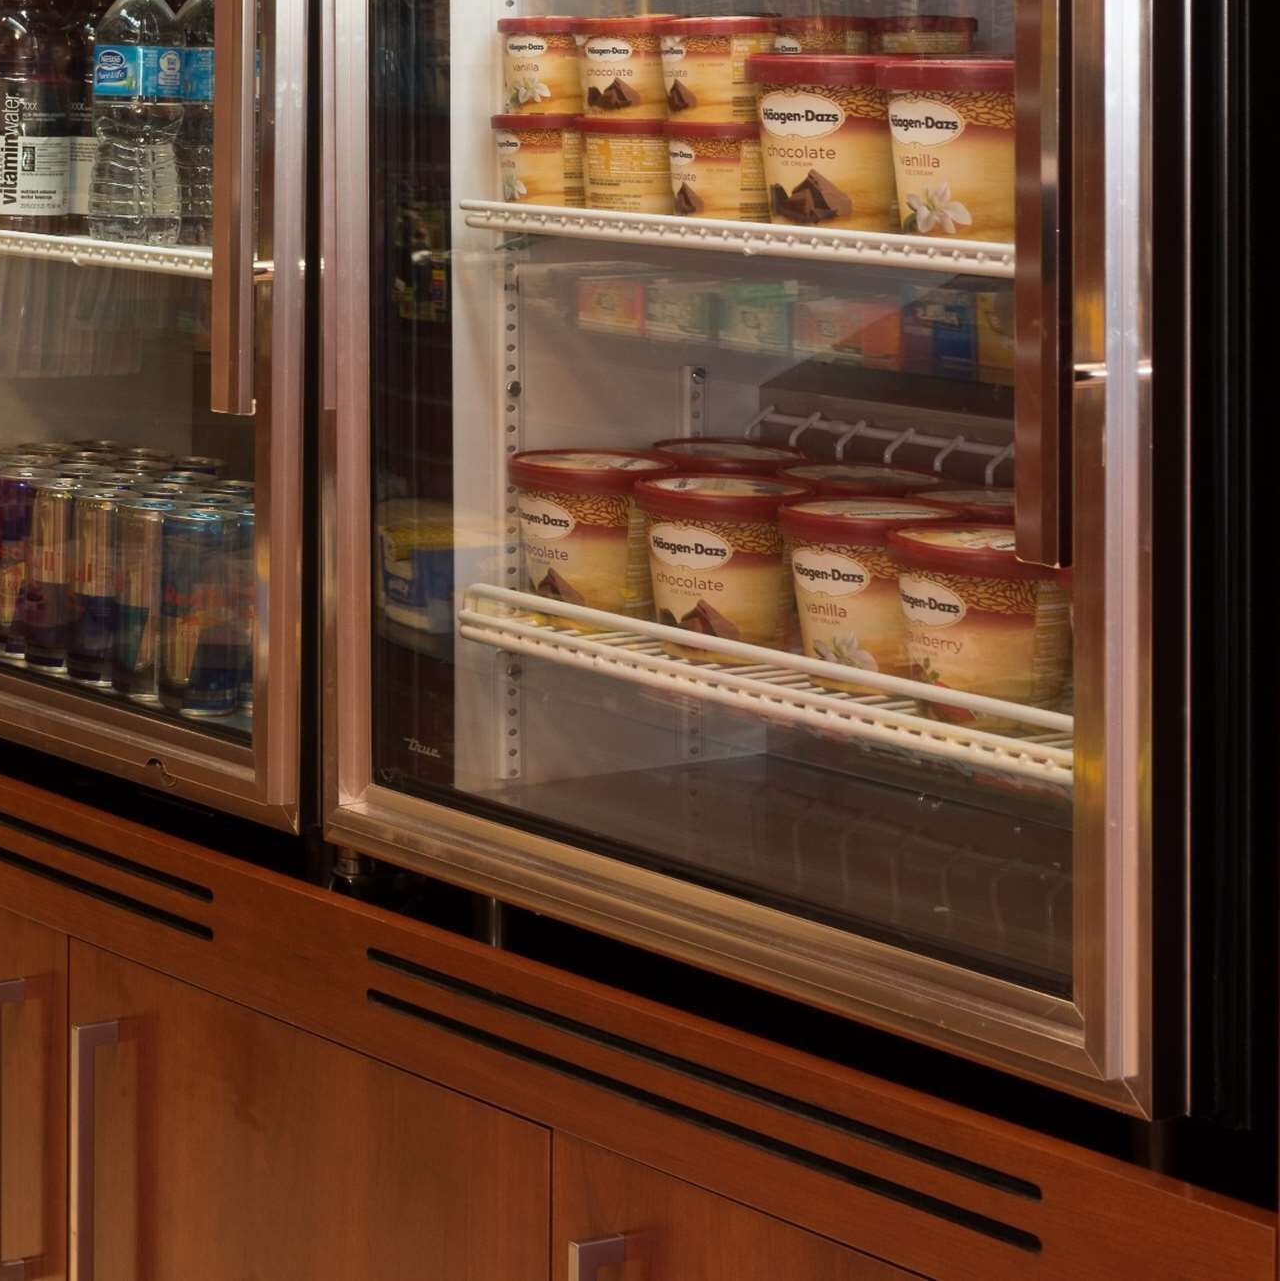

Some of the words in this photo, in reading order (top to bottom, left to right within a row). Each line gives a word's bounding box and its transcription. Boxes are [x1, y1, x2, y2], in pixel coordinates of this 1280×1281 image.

[762, 106, 839, 125] Häagen-Dazs
[767, 143, 836, 159] chocolate
[899, 153, 940, 169] vanilla
[652, 535, 728, 558] Häagen-Dazs
[655, 570, 725, 592] chocolate
[805, 600, 848, 619] vanilla
